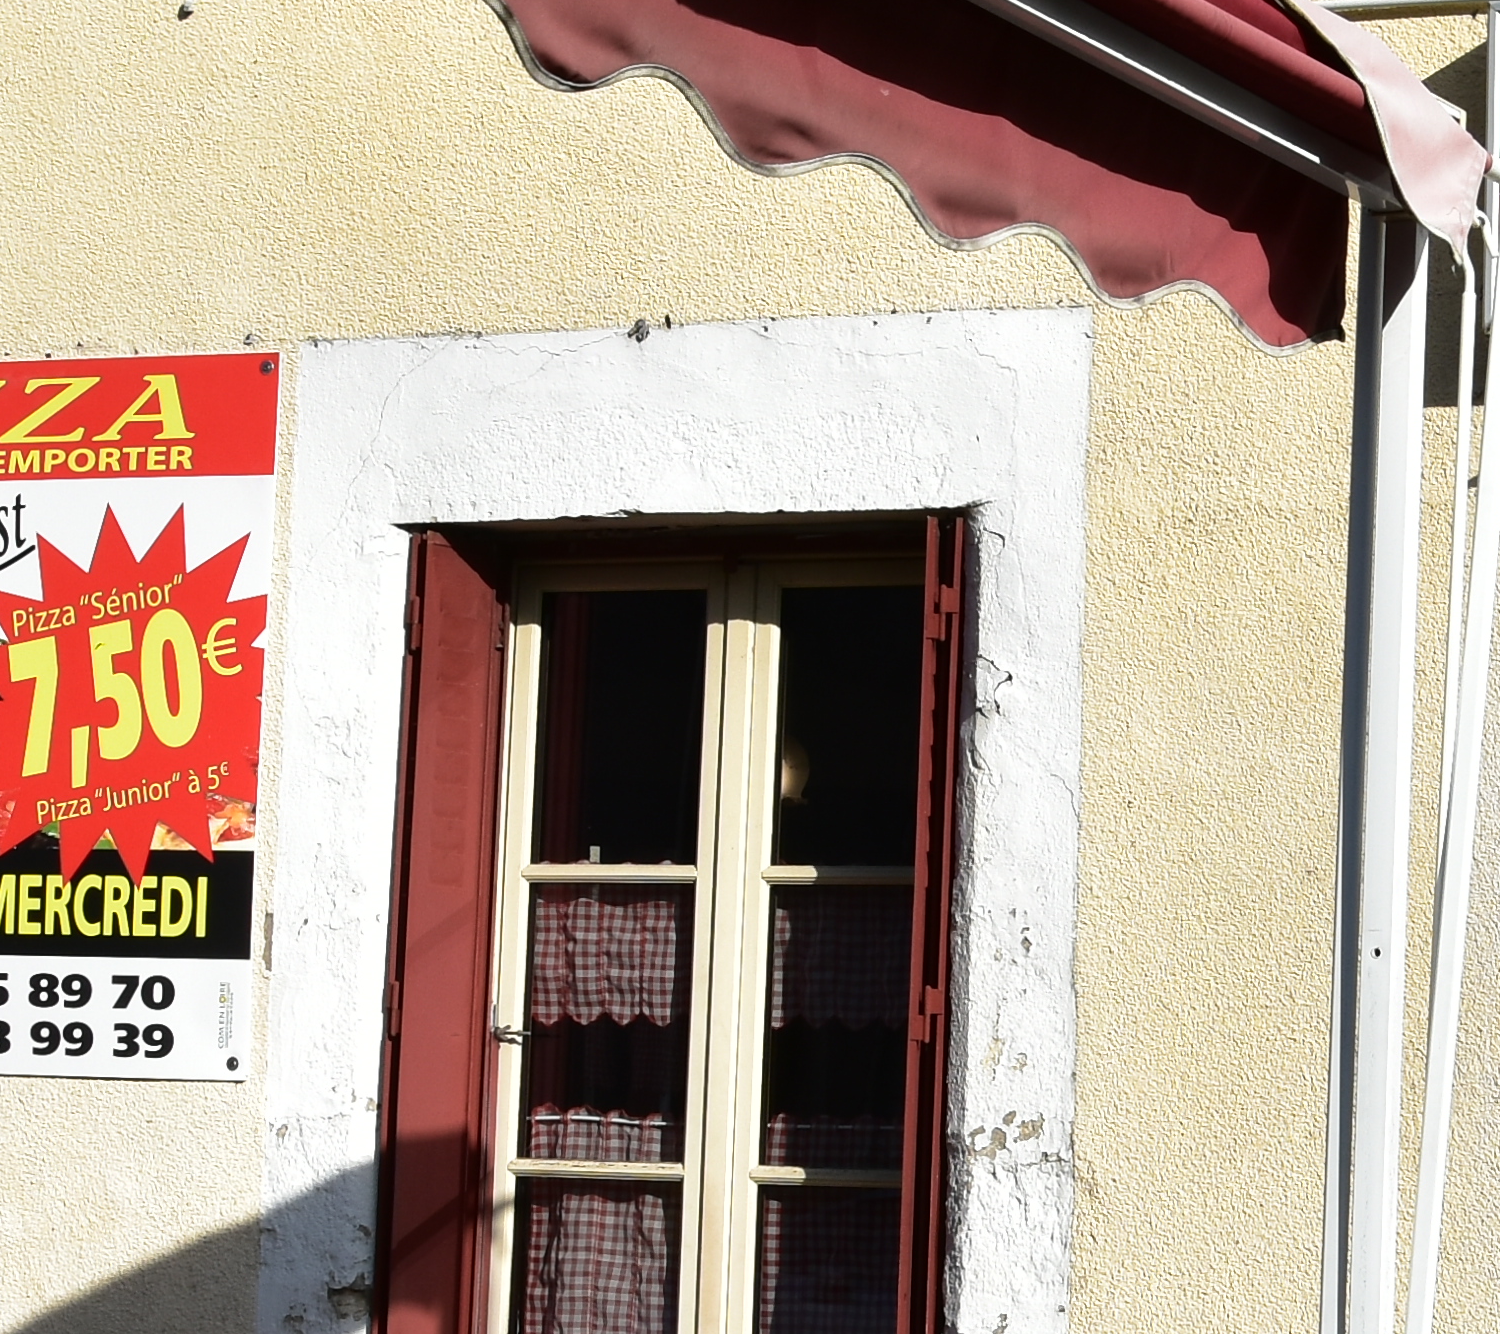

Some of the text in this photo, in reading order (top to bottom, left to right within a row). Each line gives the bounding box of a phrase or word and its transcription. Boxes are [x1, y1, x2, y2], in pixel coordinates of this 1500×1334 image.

[11, 605, 77, 638] Pizza
[36, 798, 92, 826] Pizza
[187, 766, 202, 795] à
[27, 973, 93, 1008] 89
[110, 975, 176, 1010] 70
[29, 1021, 94, 1056] 99
[112, 1023, 175, 1058] 39
